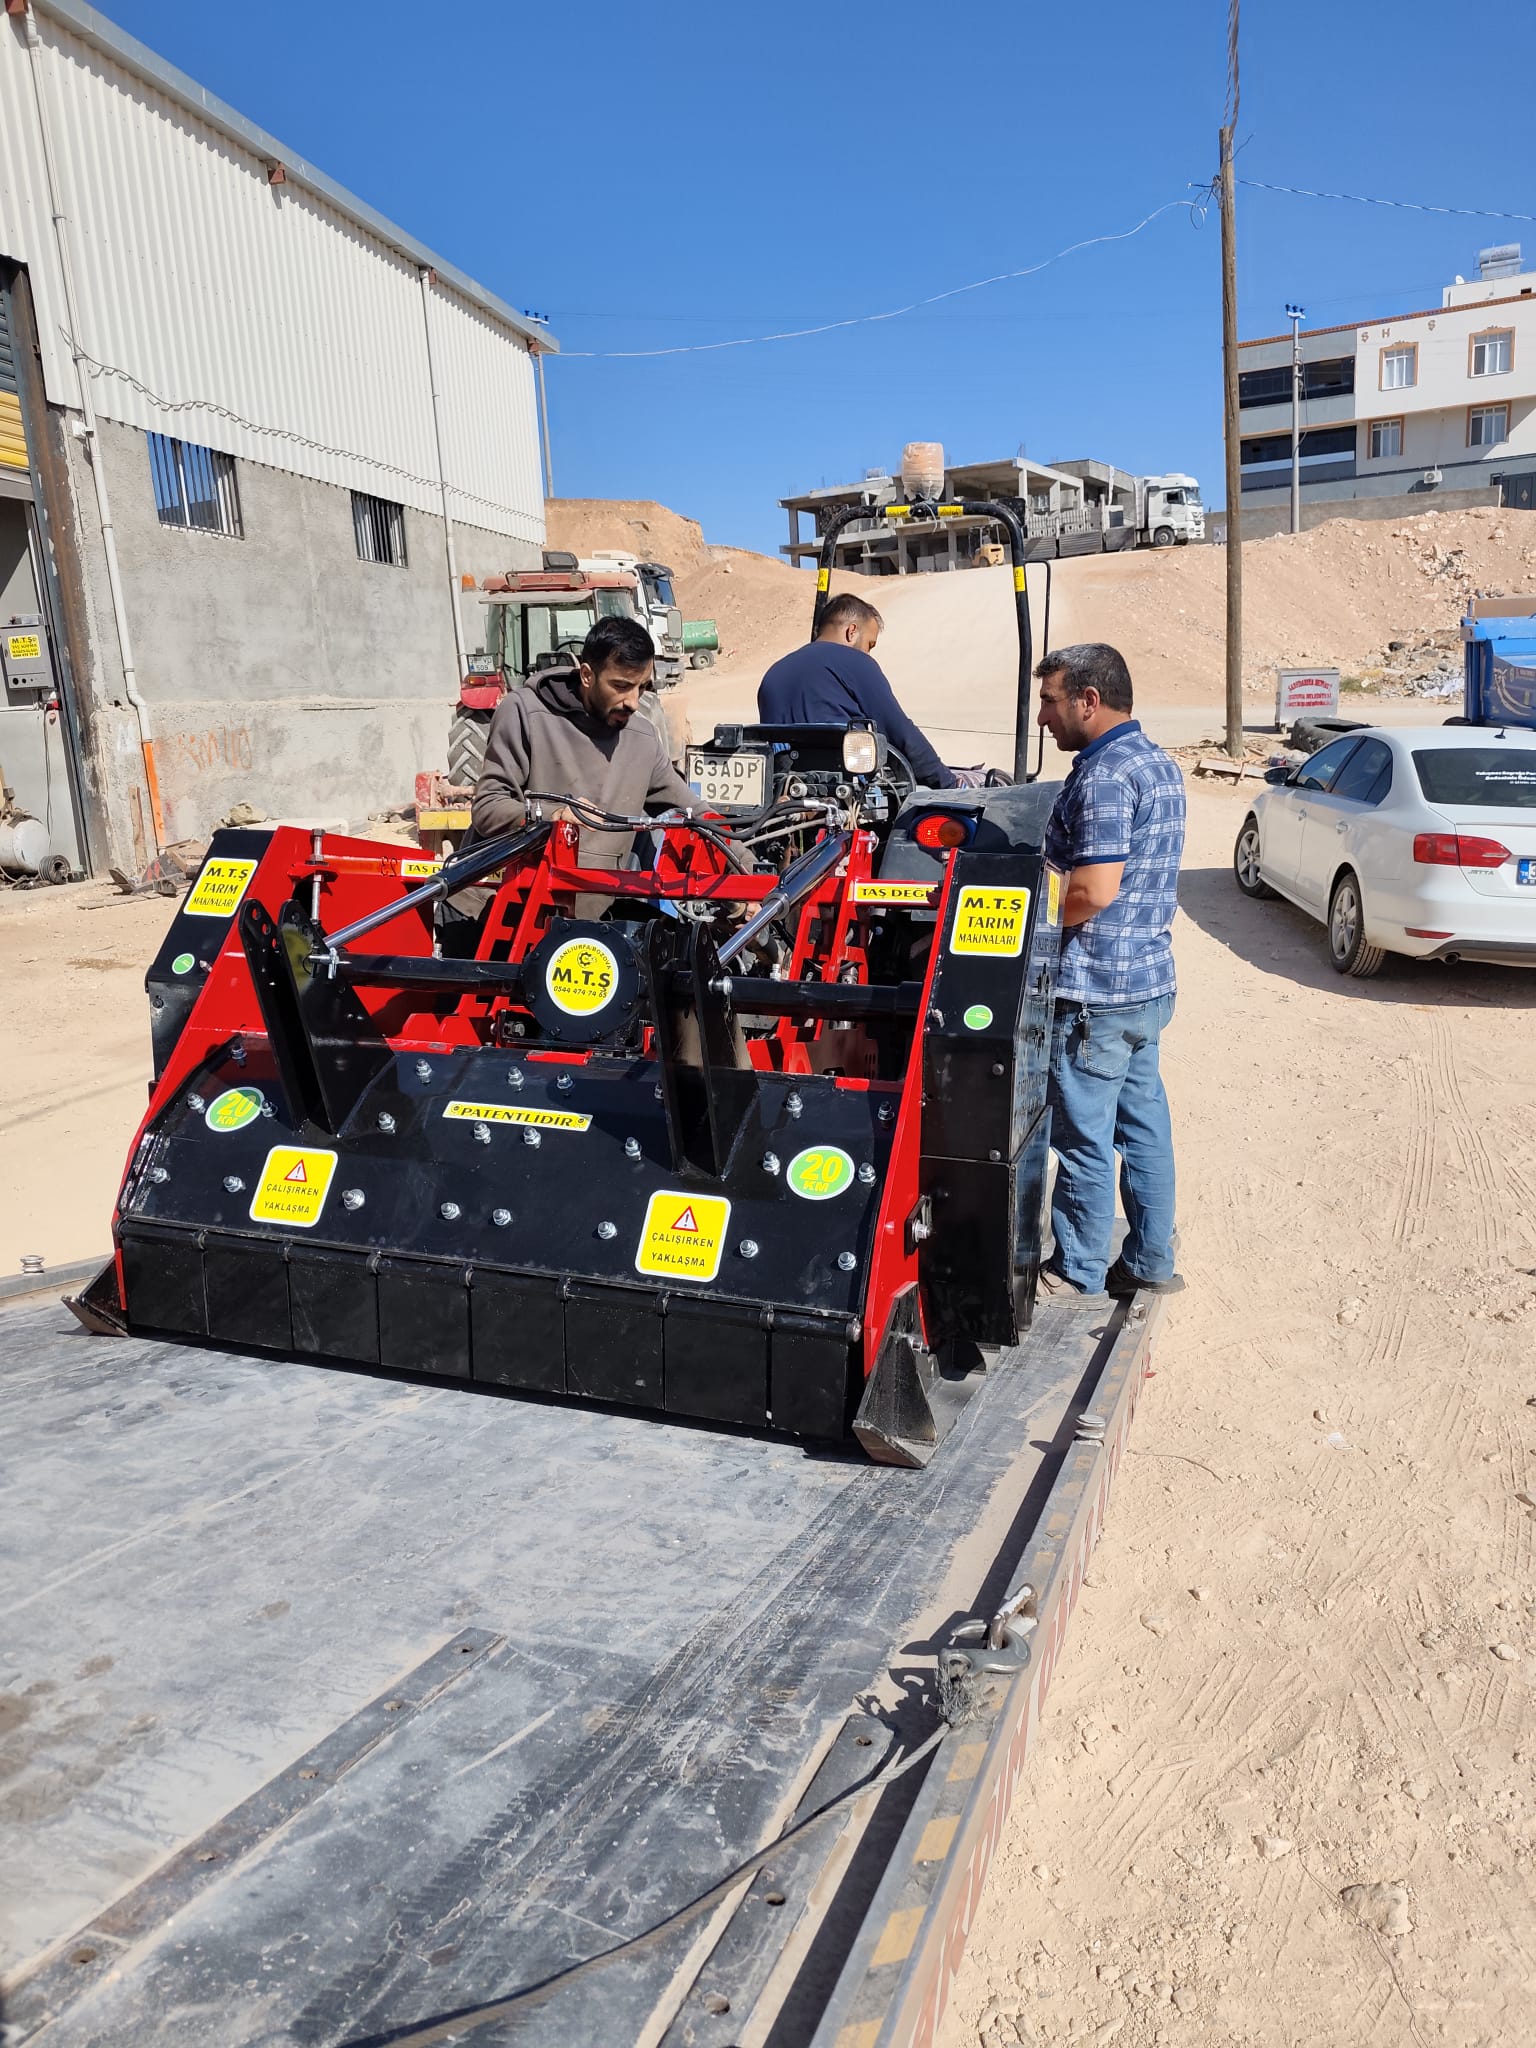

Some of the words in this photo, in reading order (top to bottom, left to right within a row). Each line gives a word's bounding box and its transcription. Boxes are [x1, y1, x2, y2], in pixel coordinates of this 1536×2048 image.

[694, 759, 760, 779] 63ADP
[706, 782, 744, 801] 927
[206, 867, 248, 882] M.T.Ş
[203, 882, 239, 894] TARIM
[964, 897, 1023, 914] M.T.Ş
[967, 916, 1015, 930] TARIM
[216, 1092, 257, 1117] 20
[460, 1106, 573, 1127] PATENTLİDİR
[799, 1153, 843, 1183] 20
[266, 1183, 319, 1196] ÇALIŞIRKEN
[803, 1180, 830, 1193] KM
[651, 1232, 714, 1248] ÇALIŞIRKEN
[651, 1251, 705, 1268] YAKLAŞMA
